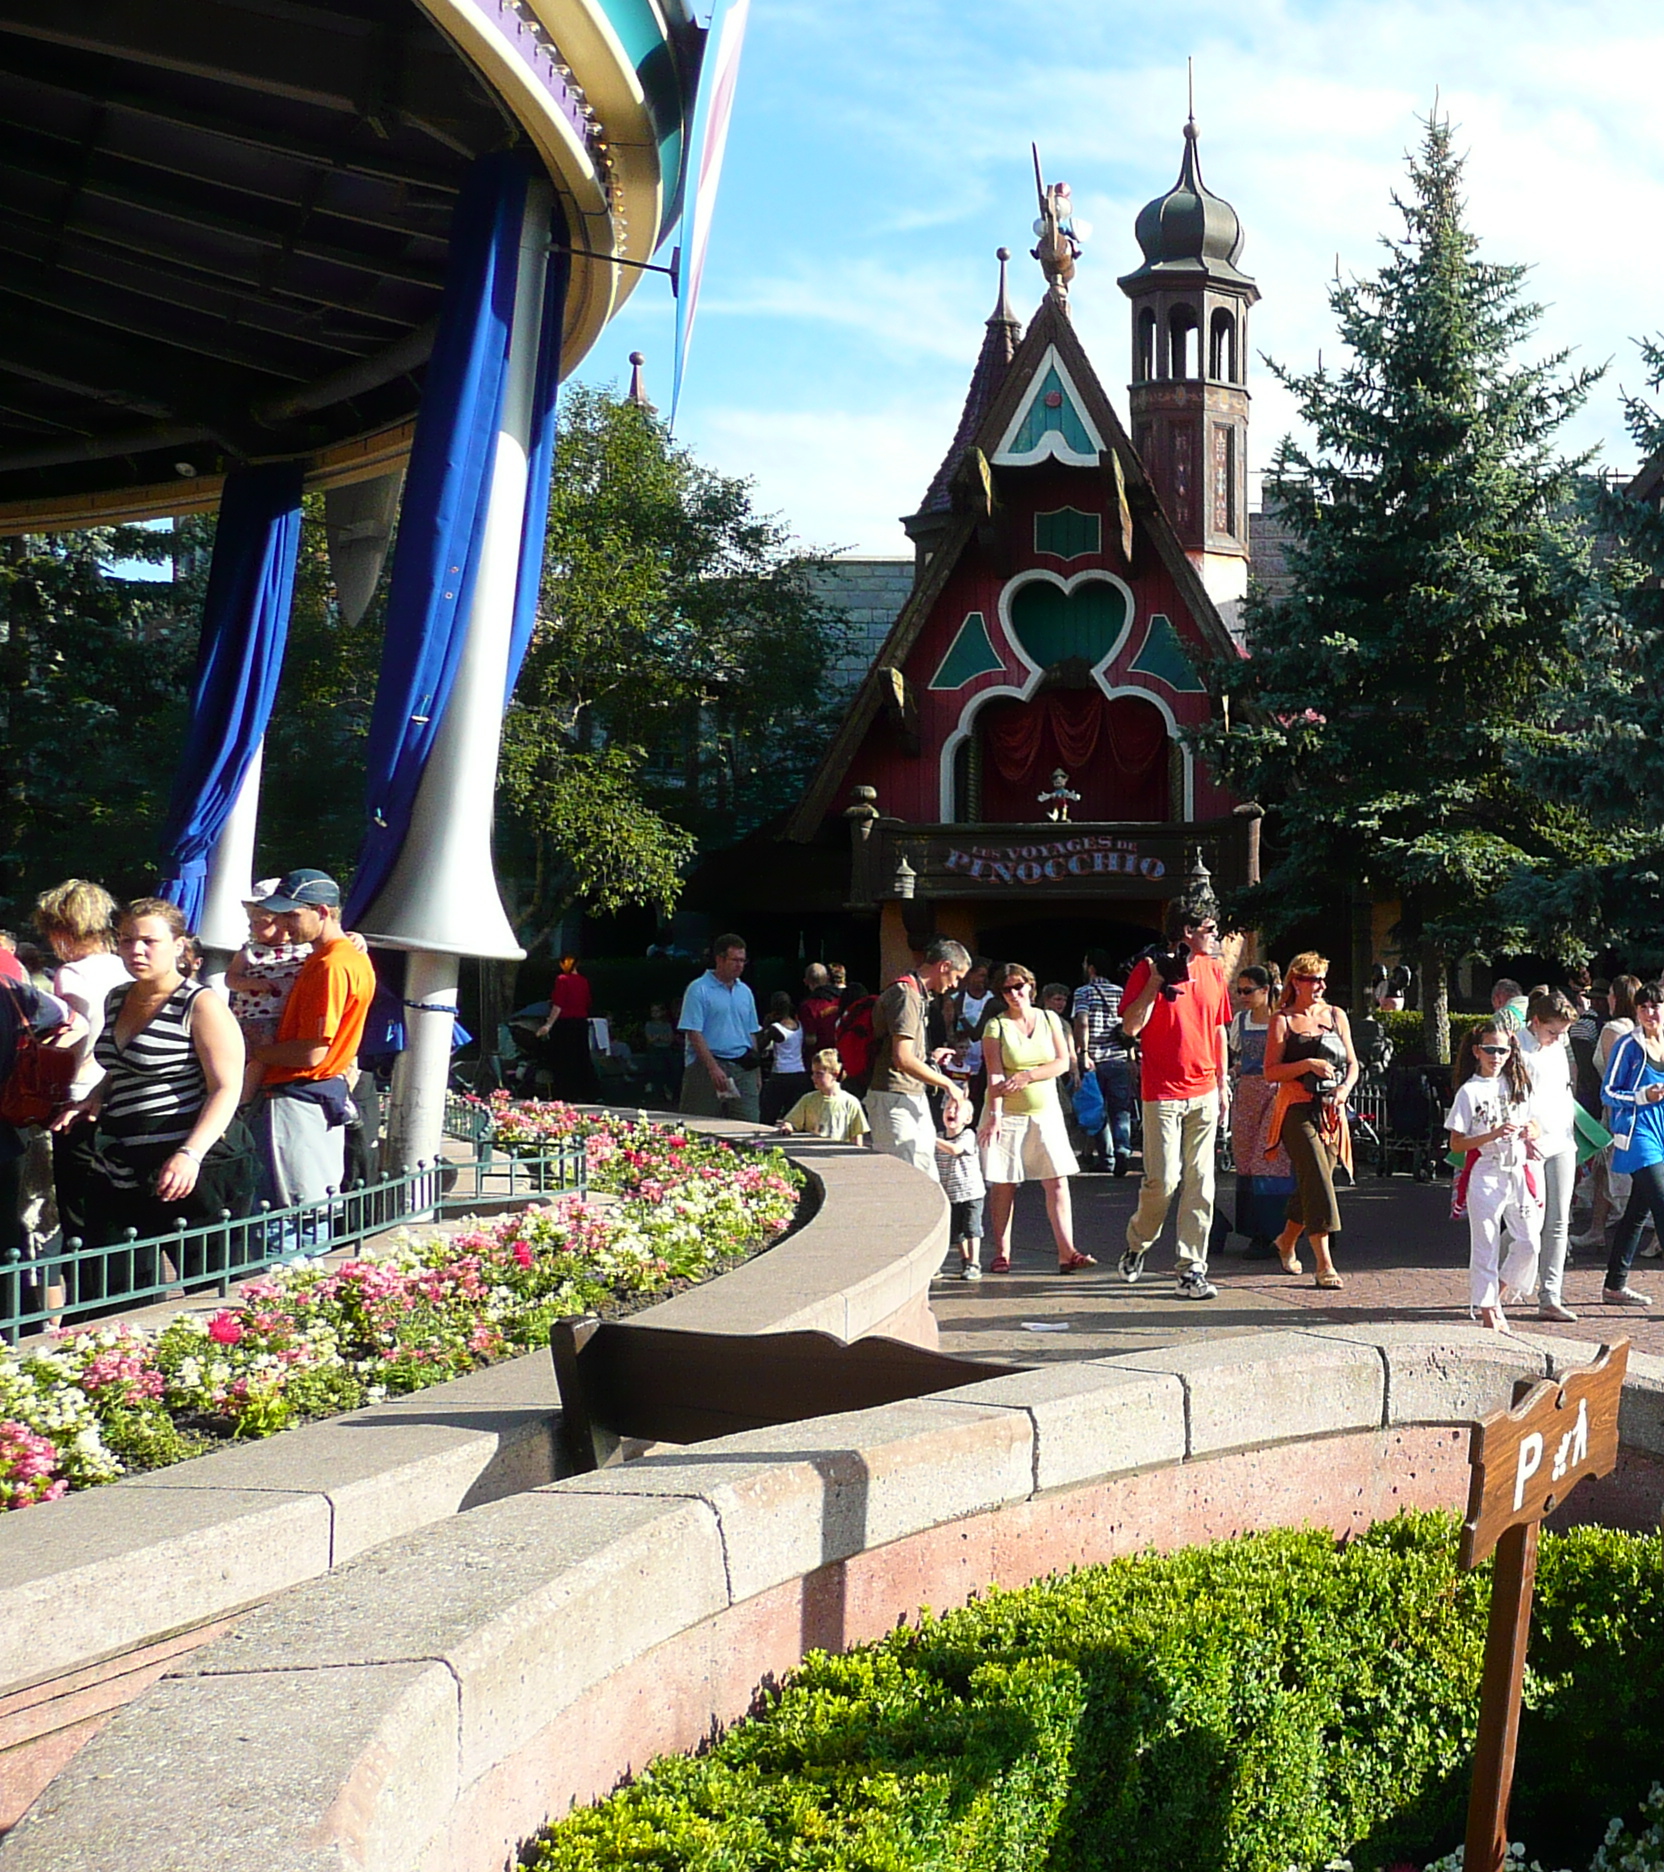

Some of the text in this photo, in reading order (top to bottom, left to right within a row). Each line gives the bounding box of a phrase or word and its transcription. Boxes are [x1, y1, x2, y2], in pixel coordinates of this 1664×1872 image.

[943, 847, 1166, 885] PINOCCHIO
[972, 835, 1138, 859] LES VOYAGES DE
[1513, 1432, 1544, 1512] P
